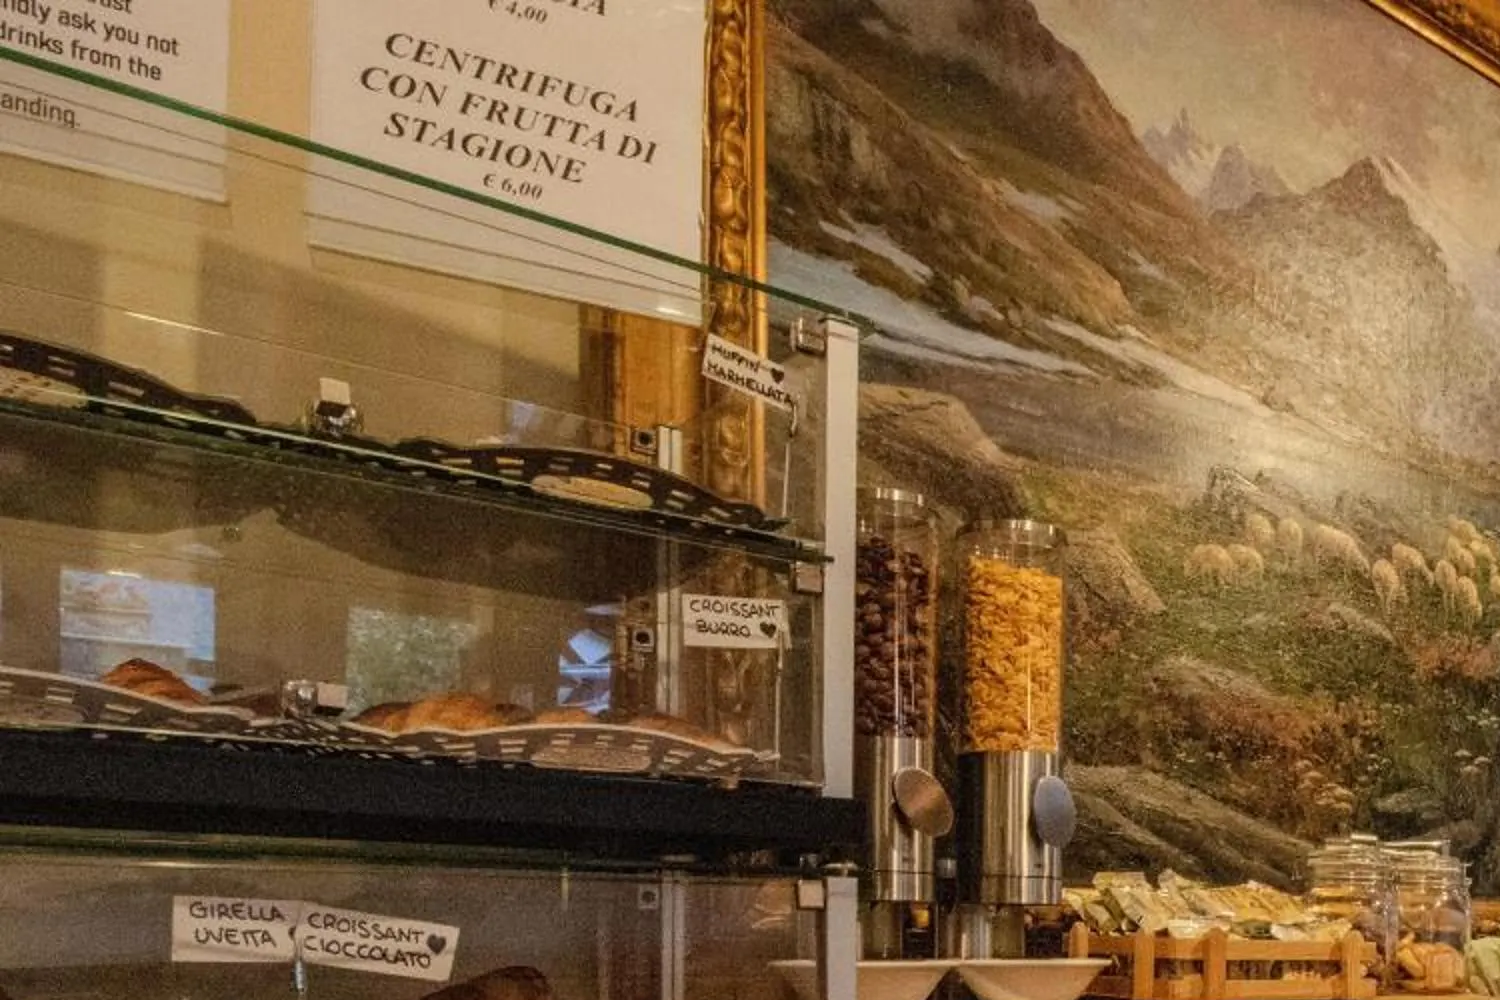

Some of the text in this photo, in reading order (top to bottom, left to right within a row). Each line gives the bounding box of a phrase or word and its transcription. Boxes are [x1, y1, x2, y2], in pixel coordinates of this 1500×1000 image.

[505, 1, 548, 24] 4,00
[57, 9, 97, 35] ask
[103, 22, 139, 46] you
[147, 34, 180, 57] not
[70, 39, 121, 71] from
[128, 56, 161, 81] the
[384, 32, 639, 123] CENTRIFUGA
[360, 66, 658, 165] CON FRUTTA DI
[383, 111, 588, 184] STAGIONE
[501, 176, 544, 201] 6,00
[689, 599, 781, 619] CROISSANT
[695, 619, 752, 639] BURRO
[189, 902, 286, 922] GIRELLA
[307, 912, 424, 944] CROISSANT
[193, 927, 278, 948] UVETTA
[303, 935, 433, 969] CIOCCOLATO
